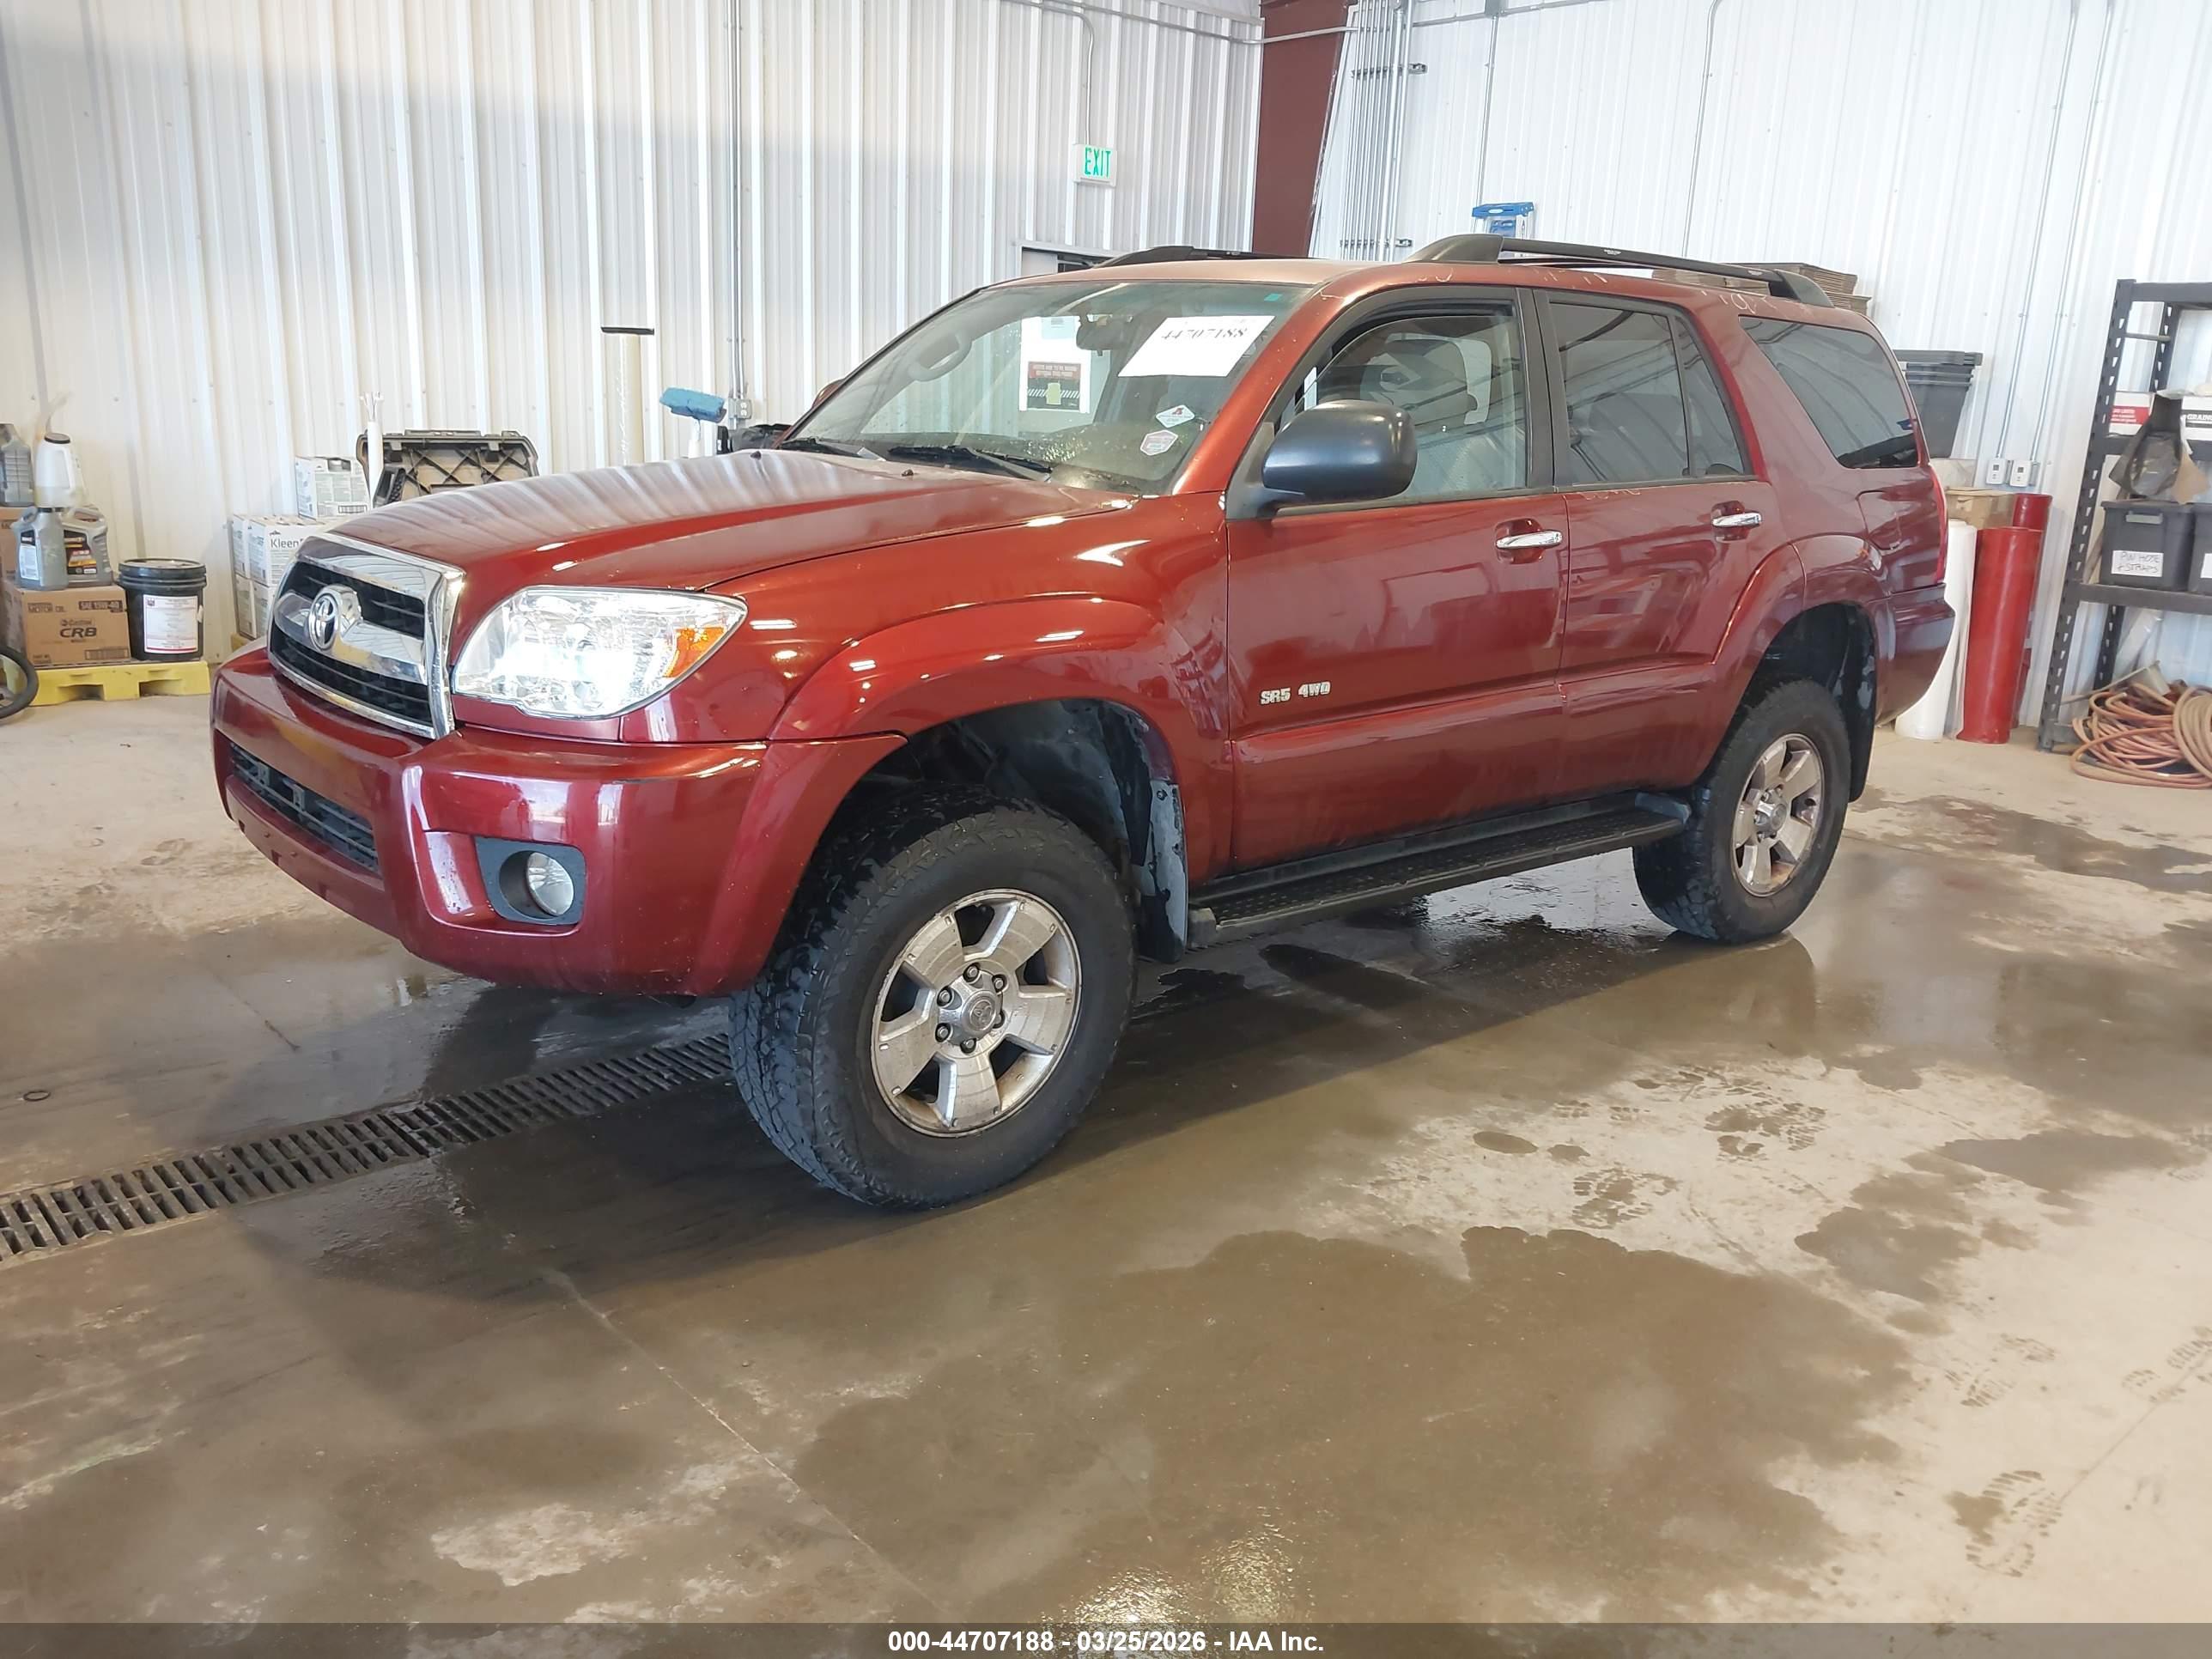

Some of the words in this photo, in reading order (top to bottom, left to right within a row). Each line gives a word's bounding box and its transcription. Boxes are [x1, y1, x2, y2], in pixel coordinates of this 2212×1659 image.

[1085, 147, 1111, 178] EXIT
[1160, 328, 1248, 340] 44707188
[60, 627, 97, 638] CRB
[1260, 688, 1291, 704] SR5
[1298, 681, 1331, 697] 4WD
